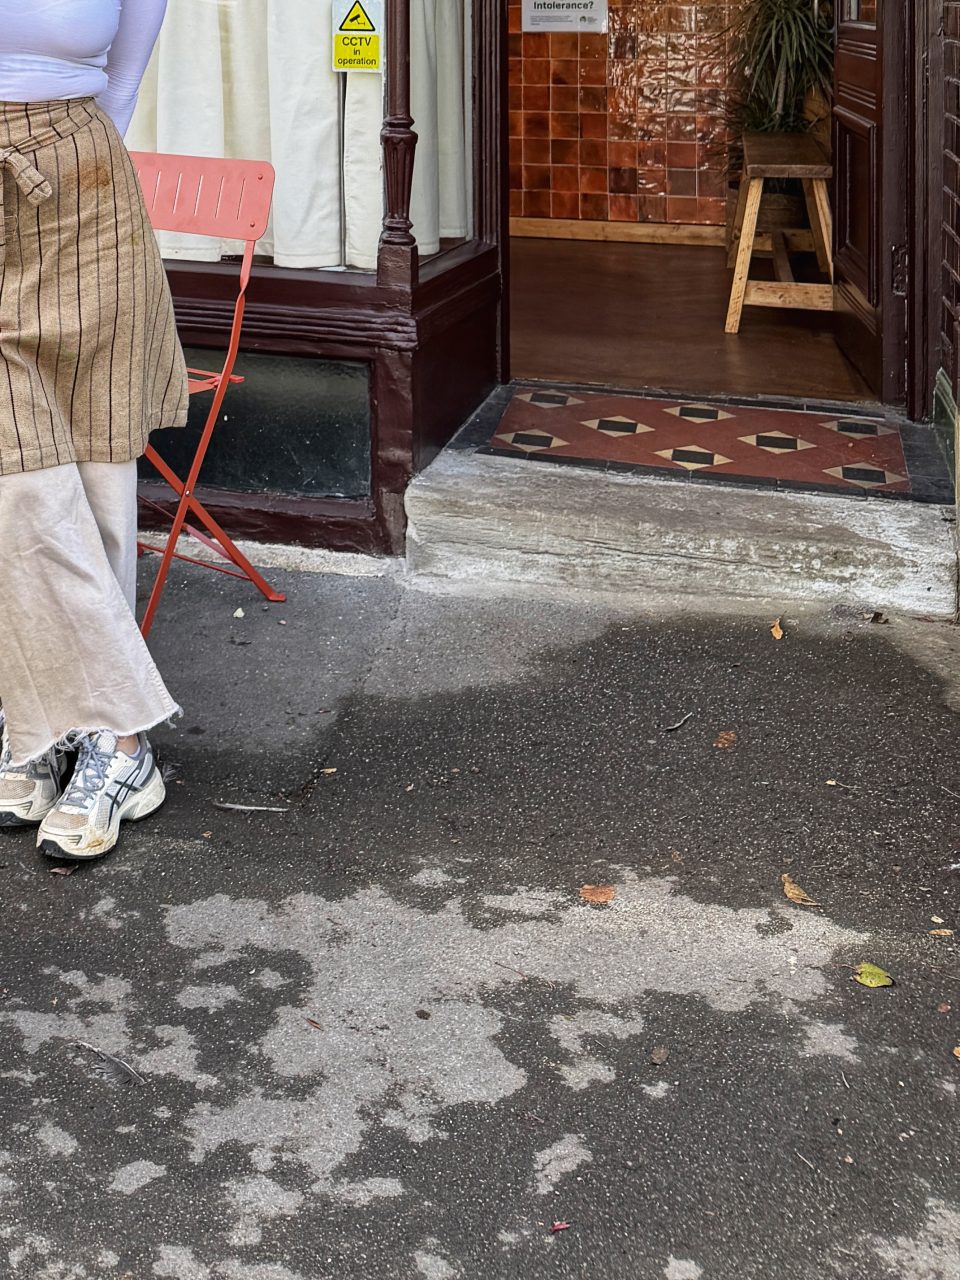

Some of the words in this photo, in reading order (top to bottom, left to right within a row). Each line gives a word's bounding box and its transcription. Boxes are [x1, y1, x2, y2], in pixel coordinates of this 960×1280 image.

[533, 1, 594, 10] Intolerance?
[342, 36, 372, 47] CCTV
[338, 57, 377, 66] operation
